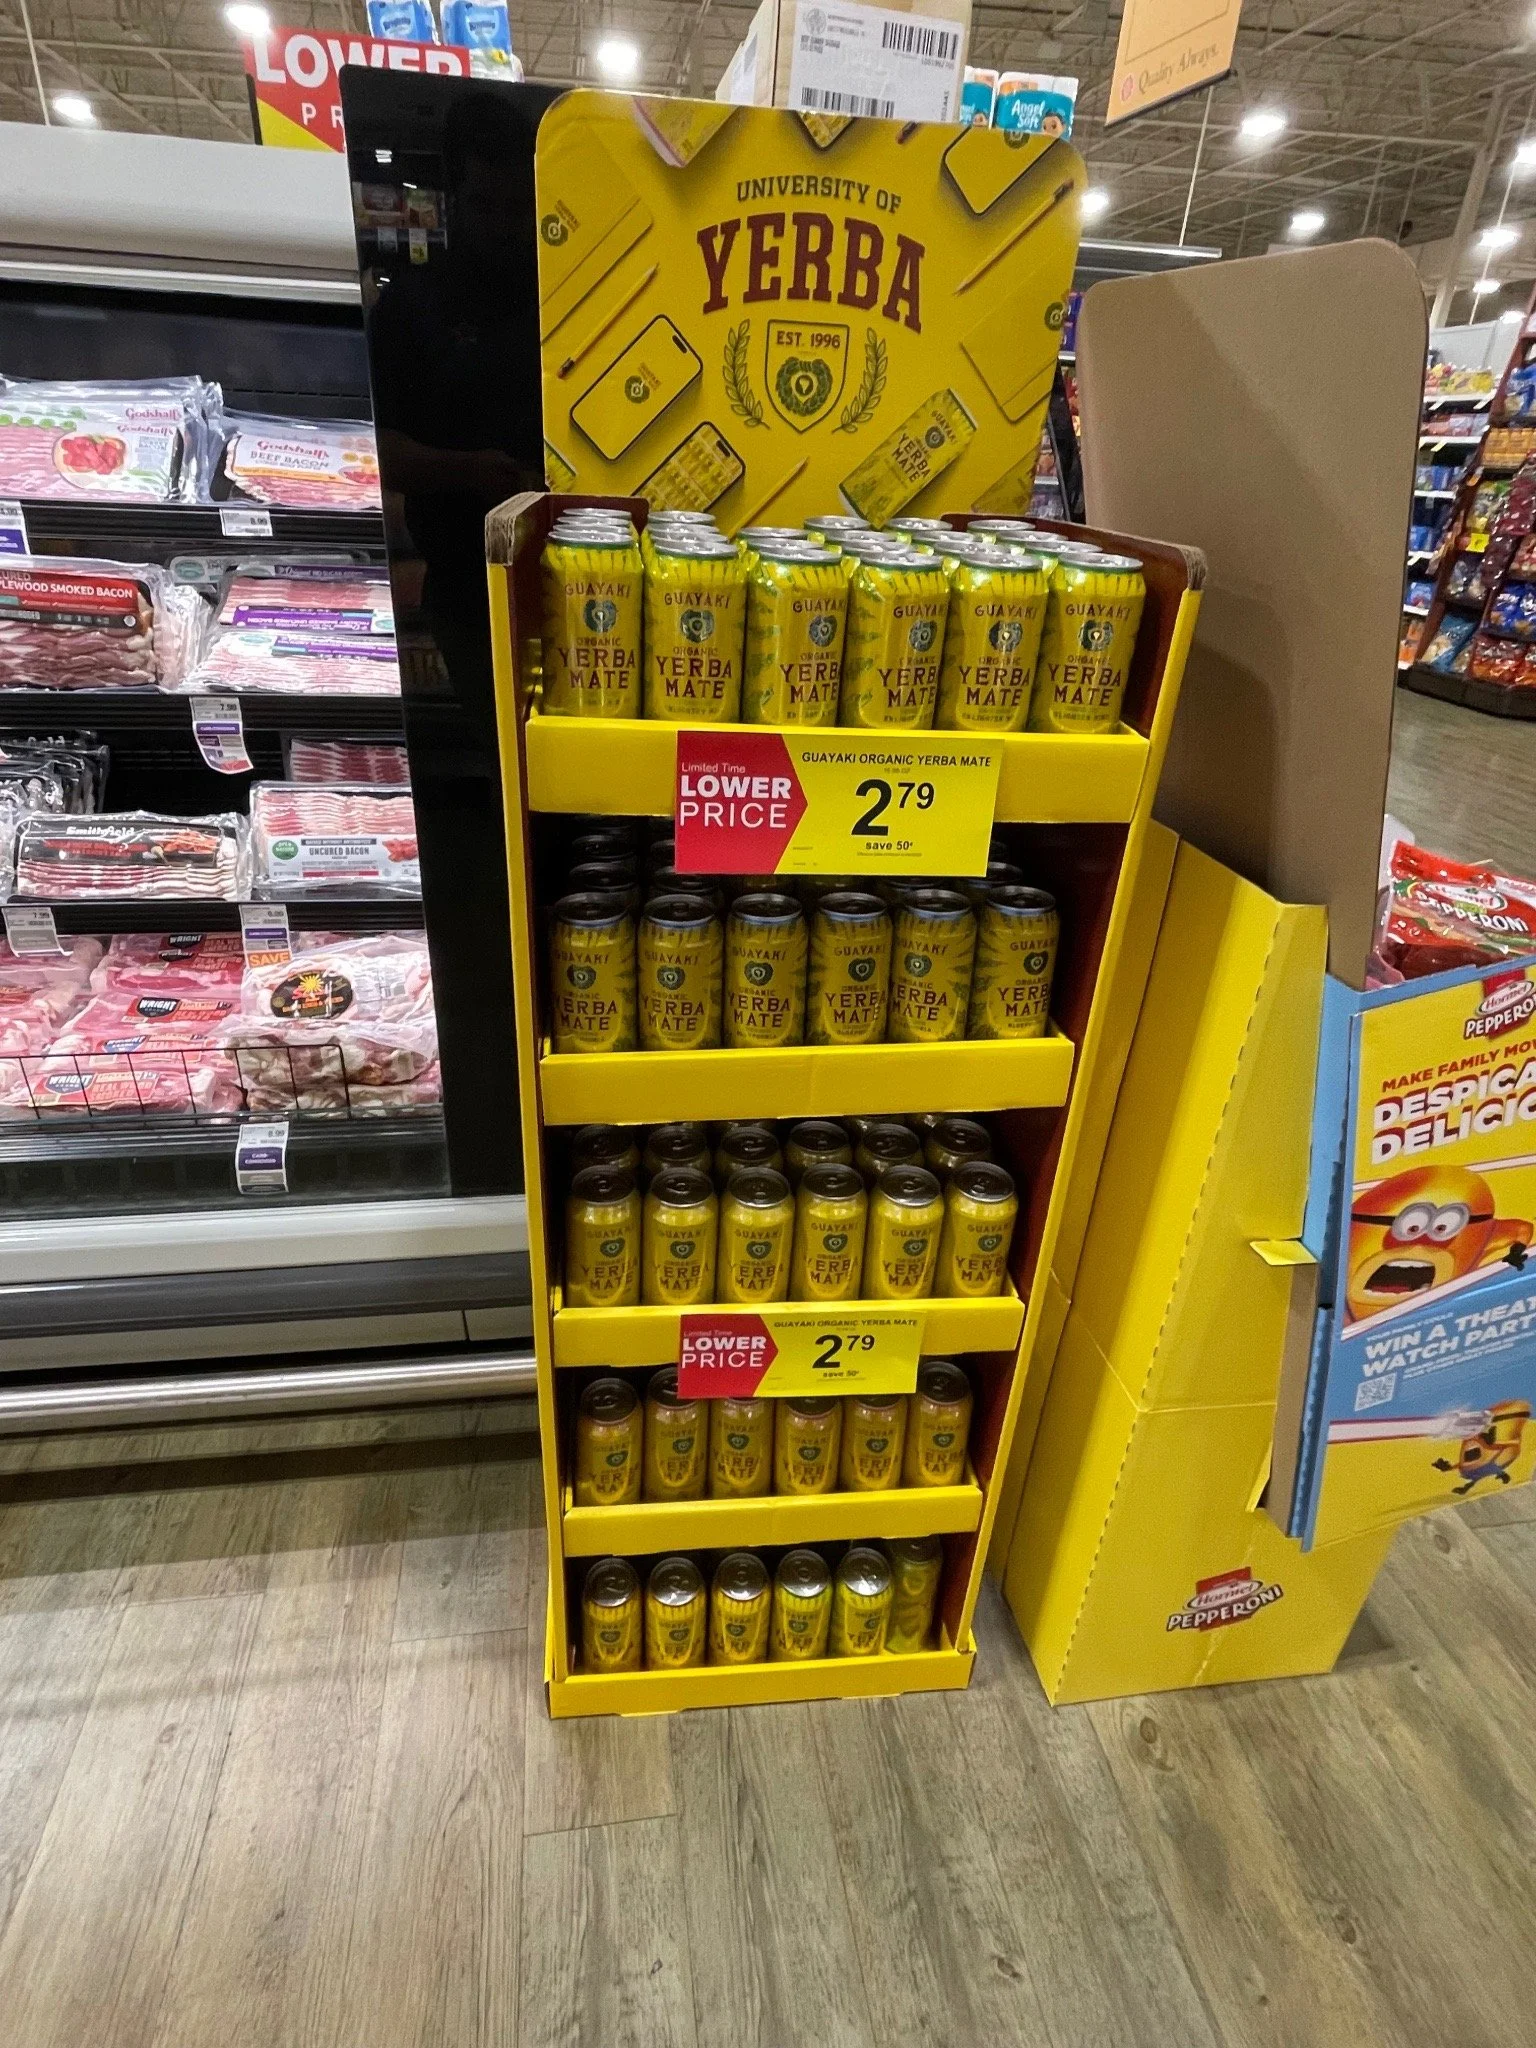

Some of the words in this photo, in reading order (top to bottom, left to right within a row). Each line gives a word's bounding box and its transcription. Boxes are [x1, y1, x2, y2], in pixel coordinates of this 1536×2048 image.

[736, 174, 870, 204] UNIVERSITY
[876, 188, 902, 214] OF
[697, 211, 926, 335] YERBA
[776, 330, 804, 347] EST.
[811, 332, 841, 350] 1996
[250, 451, 281, 463] BEEF
[284, 455, 330, 469] BACON
[891, 447, 921, 483] MATE
[898, 432, 932, 479] YERBA
[0, 571, 31, 581] URED
[0, 580, 48, 593] LEWOOD
[51, 583, 94, 597] SMOKED
[97, 587, 133, 599] BACON
[564, 582, 632, 598] GUAYAKI
[664, 592, 730, 610] GUAYAKI
[974, 604, 1039, 621] GUAYAKI
[1065, 604, 1131, 621] GUAYAKI
[575, 637, 621, 648] ORGANIC
[558, 648, 636, 669] YERBA
[656, 656, 733, 679] YERBA
[569, 671, 630, 690] MATE
[780, 663, 840, 684] YERB
[878, 668, 937, 688] YERB
[959, 667, 1031, 687] YERBA
[1048, 664, 1121, 687] YERBA
[665, 679, 725, 700] MATE
[790, 684, 839, 704] MATE
[887, 687, 936, 708] MATE
[966, 688, 1023, 707] MATE
[1053, 686, 1114, 707] MATE
[681, 762, 719, 774] Limited
[722, 763, 746, 774] Time
[801, 751, 856, 763] GUAYAKI
[859, 753, 914, 766] ORGANIC
[917, 755, 957, 767] YERBA
[960, 756, 991, 768] MATE
[680, 774, 792, 800] LOWER
[679, 801, 788, 829] PRICE
[851, 778, 893, 837] 2
[897, 781, 935, 810] 79
[65, 825, 135, 839] Smithfield
[309, 847, 343, 856] UNCURED
[345, 847, 370, 856] BACON
[865, 841, 893, 851] save
[734, 947, 788, 961] GUAYAKI
[901, 941, 949, 956] UAYAKI
[1010, 940, 1055, 952] GUAYAK
[249, 951, 289, 968] SAVE
[892, 983, 948, 1007] ERBA
[997, 983, 1049, 1002] YERB
[139, 999, 177, 1012] WRIGHT
[643, 997, 705, 1016] YERBA
[729, 992, 791, 1013] YERBA
[1005, 1000, 1048, 1017] MATE
[561, 1014, 611, 1031] MATE
[648, 1015, 697, 1032] MATE
[734, 1010, 783, 1028] MATE
[834, 1006, 881, 1024] MATE
[1465, 993, 1536, 1038] PEPPERO
[49, 1074, 93, 1087] WRIGHT
[1382, 1067, 1434, 1093] MAKE
[1438, 1049, 1500, 1077] FAMILY
[956, 1254, 1006, 1271] YERB
[589, 1271, 633, 1291] MATE
[1366, 1330, 1422, 1360] WIN
[1426, 1323, 1447, 1342] A
[1455, 1295, 1536, 1332] THEAT
[682, 1335, 767, 1351] LOWER
[812, 1333, 843, 1369] 2
[846, 1334, 876, 1352] 79
[1362, 1335, 1460, 1378] WATCH
[1464, 1312, 1536, 1347] PART
[681, 1351, 764, 1369] PRICE
[1167, 1585, 1282, 1631] PEPPERONI
